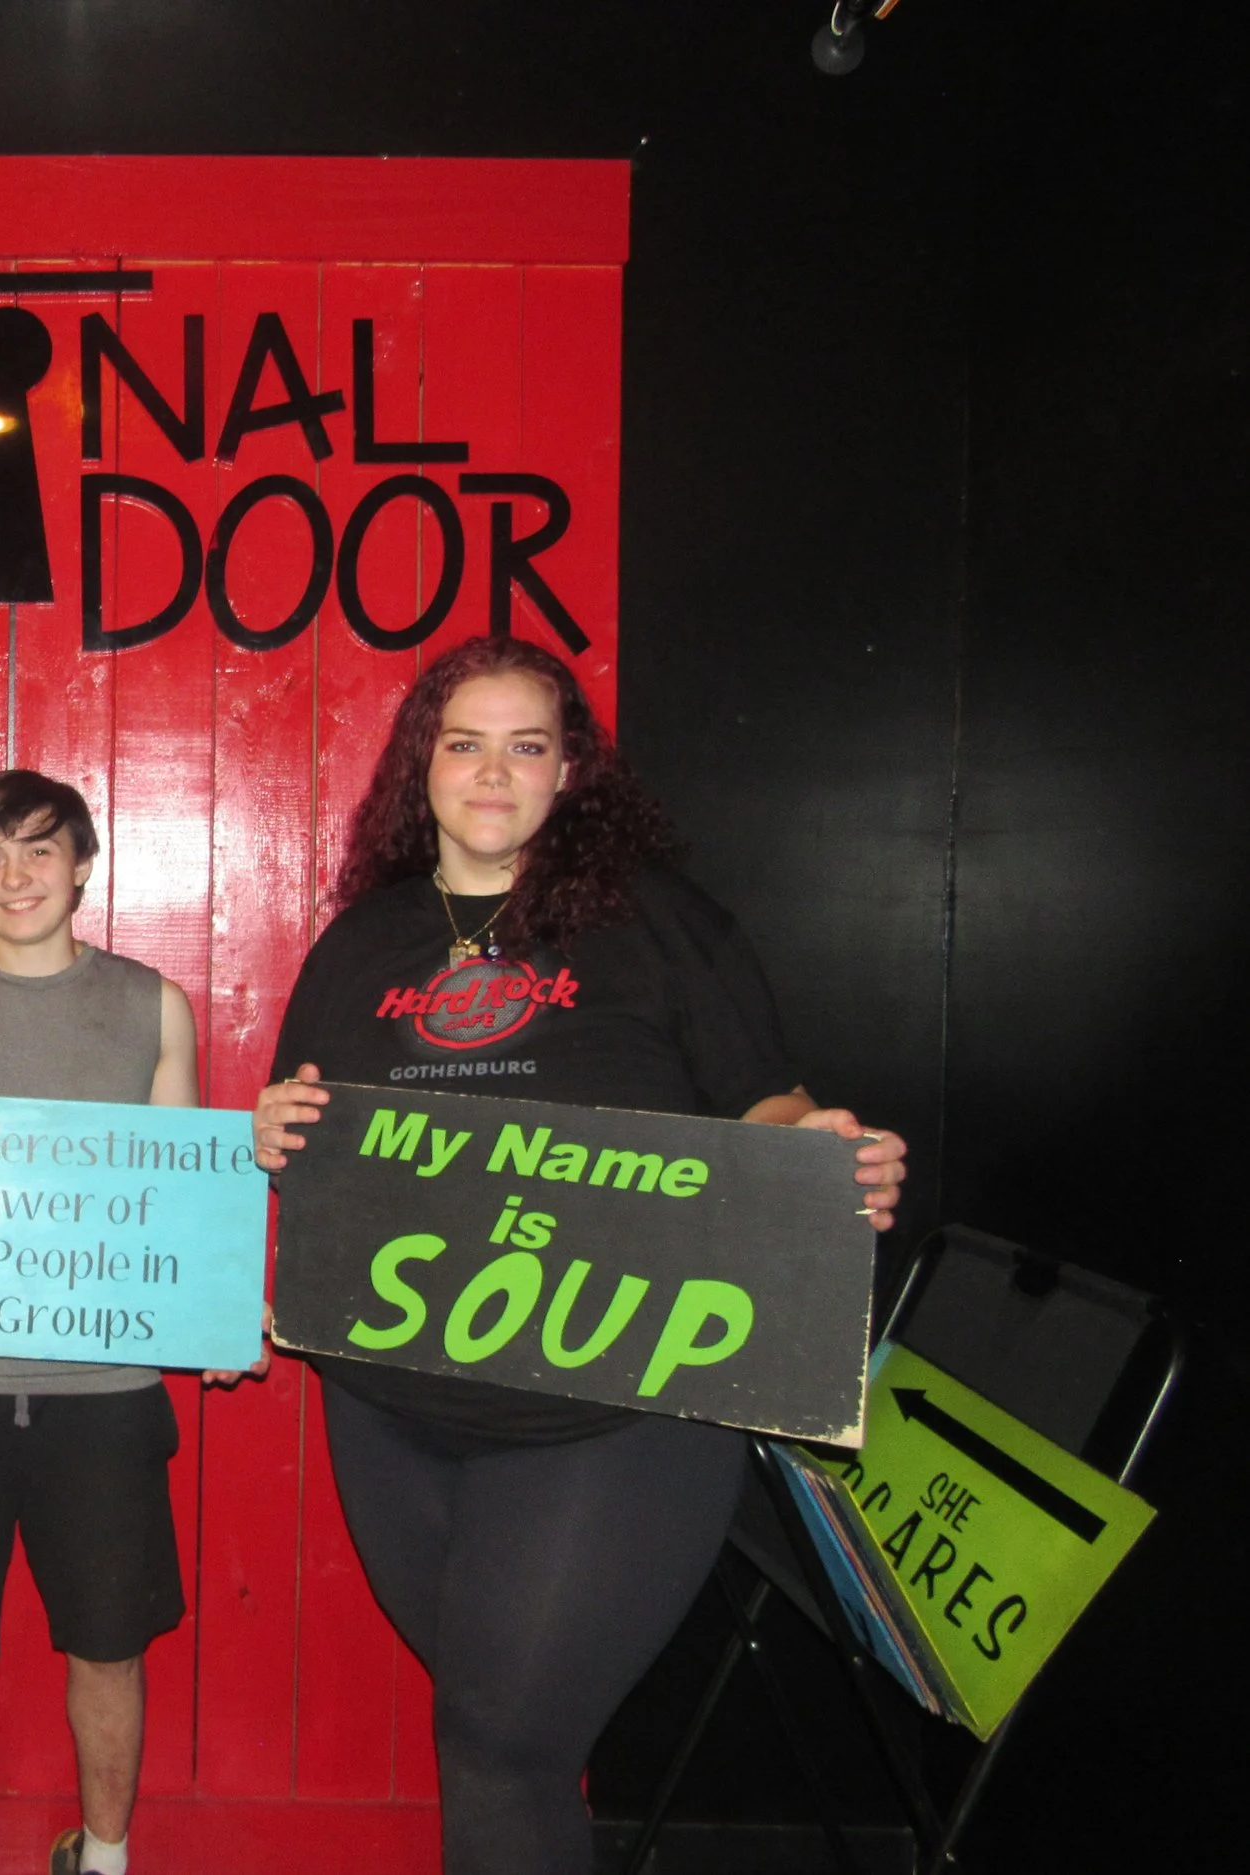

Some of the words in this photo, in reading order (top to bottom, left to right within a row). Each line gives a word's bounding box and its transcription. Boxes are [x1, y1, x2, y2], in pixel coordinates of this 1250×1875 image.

[80, 473, 591, 657] DOOR
[376, 978, 482, 1018] Hard
[478, 968, 580, 1009] Rock
[442, 1011, 496, 1031] CAFE
[389, 1059, 537, 1081] GOTHENBURG
[359, 1108, 472, 1178] My
[486, 1123, 709, 1198] Name
[107, 1186, 158, 1226] of
[489, 1196, 558, 1250] is
[143, 1245, 179, 1285] in
[347, 1234, 755, 1398] SOUP
[919, 1472, 982, 1533] SHE
